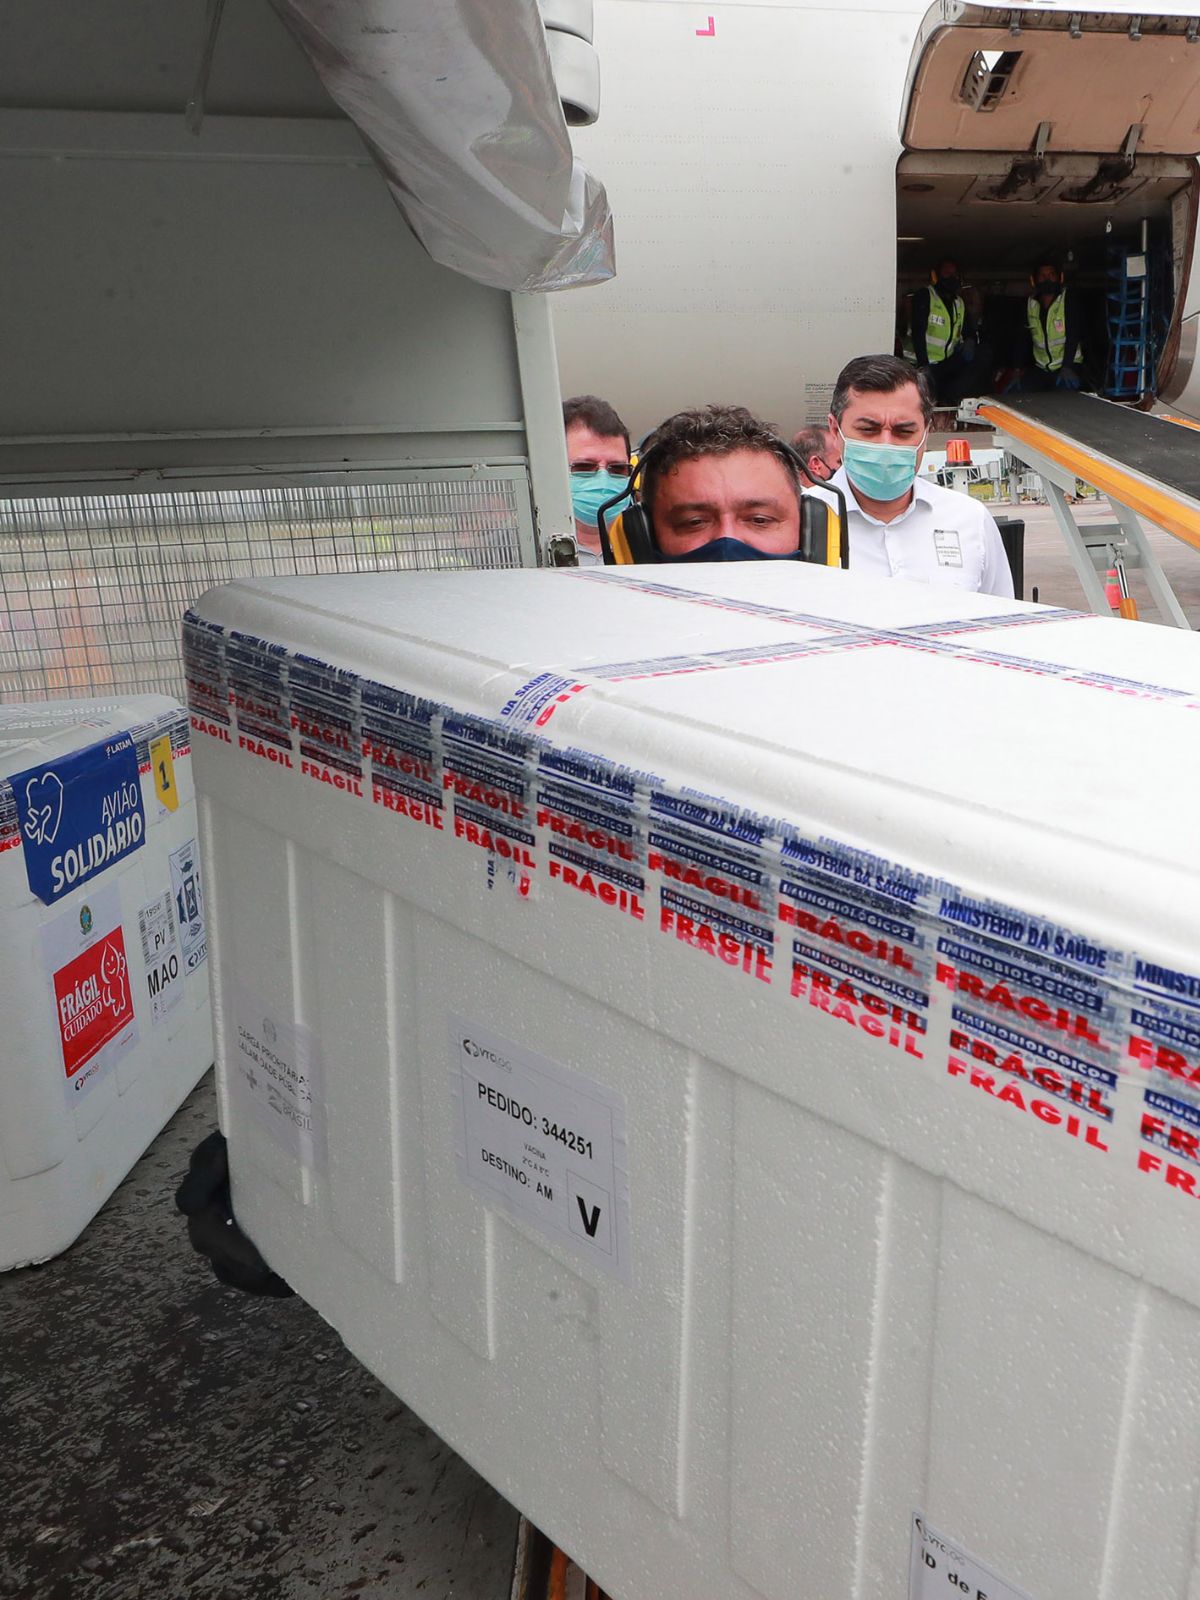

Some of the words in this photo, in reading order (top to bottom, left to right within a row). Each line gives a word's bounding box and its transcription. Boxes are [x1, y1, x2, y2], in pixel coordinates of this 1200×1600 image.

[110, 738, 133, 754] LATAM
[190, 716, 232, 744] RÁGIL
[238, 735, 293, 769] FRÁGIL
[159, 761, 170, 791] 1
[301, 760, 363, 798] FRÁGIL
[102, 781, 138, 825] AVIÃO
[51, 812, 142, 893] SOLIDÁRIO
[454, 816, 536, 869] FRÁGIL
[549, 860, 645, 922] FRÁGIL
[154, 929, 166, 951] PV
[778, 902, 913, 972] FRÁGIL
[147, 954, 179, 999] MAO
[59, 973, 101, 1026] FRÁGIL
[64, 1000, 103, 1042] CUIDADO
[936, 962, 1101, 1044] FRÁGIL
[478, 1081, 538, 1130] PEDIDO:
[542, 1117, 593, 1160] 344251
[947, 1054, 1109, 1153] FRÁGIL
[481, 1148, 530, 1188] DESTINO:
[536, 1182, 553, 1201] AM
[576, 1195, 601, 1238] V
[922, 1548, 937, 1569] ID
[948, 1572, 970, 1594] de
